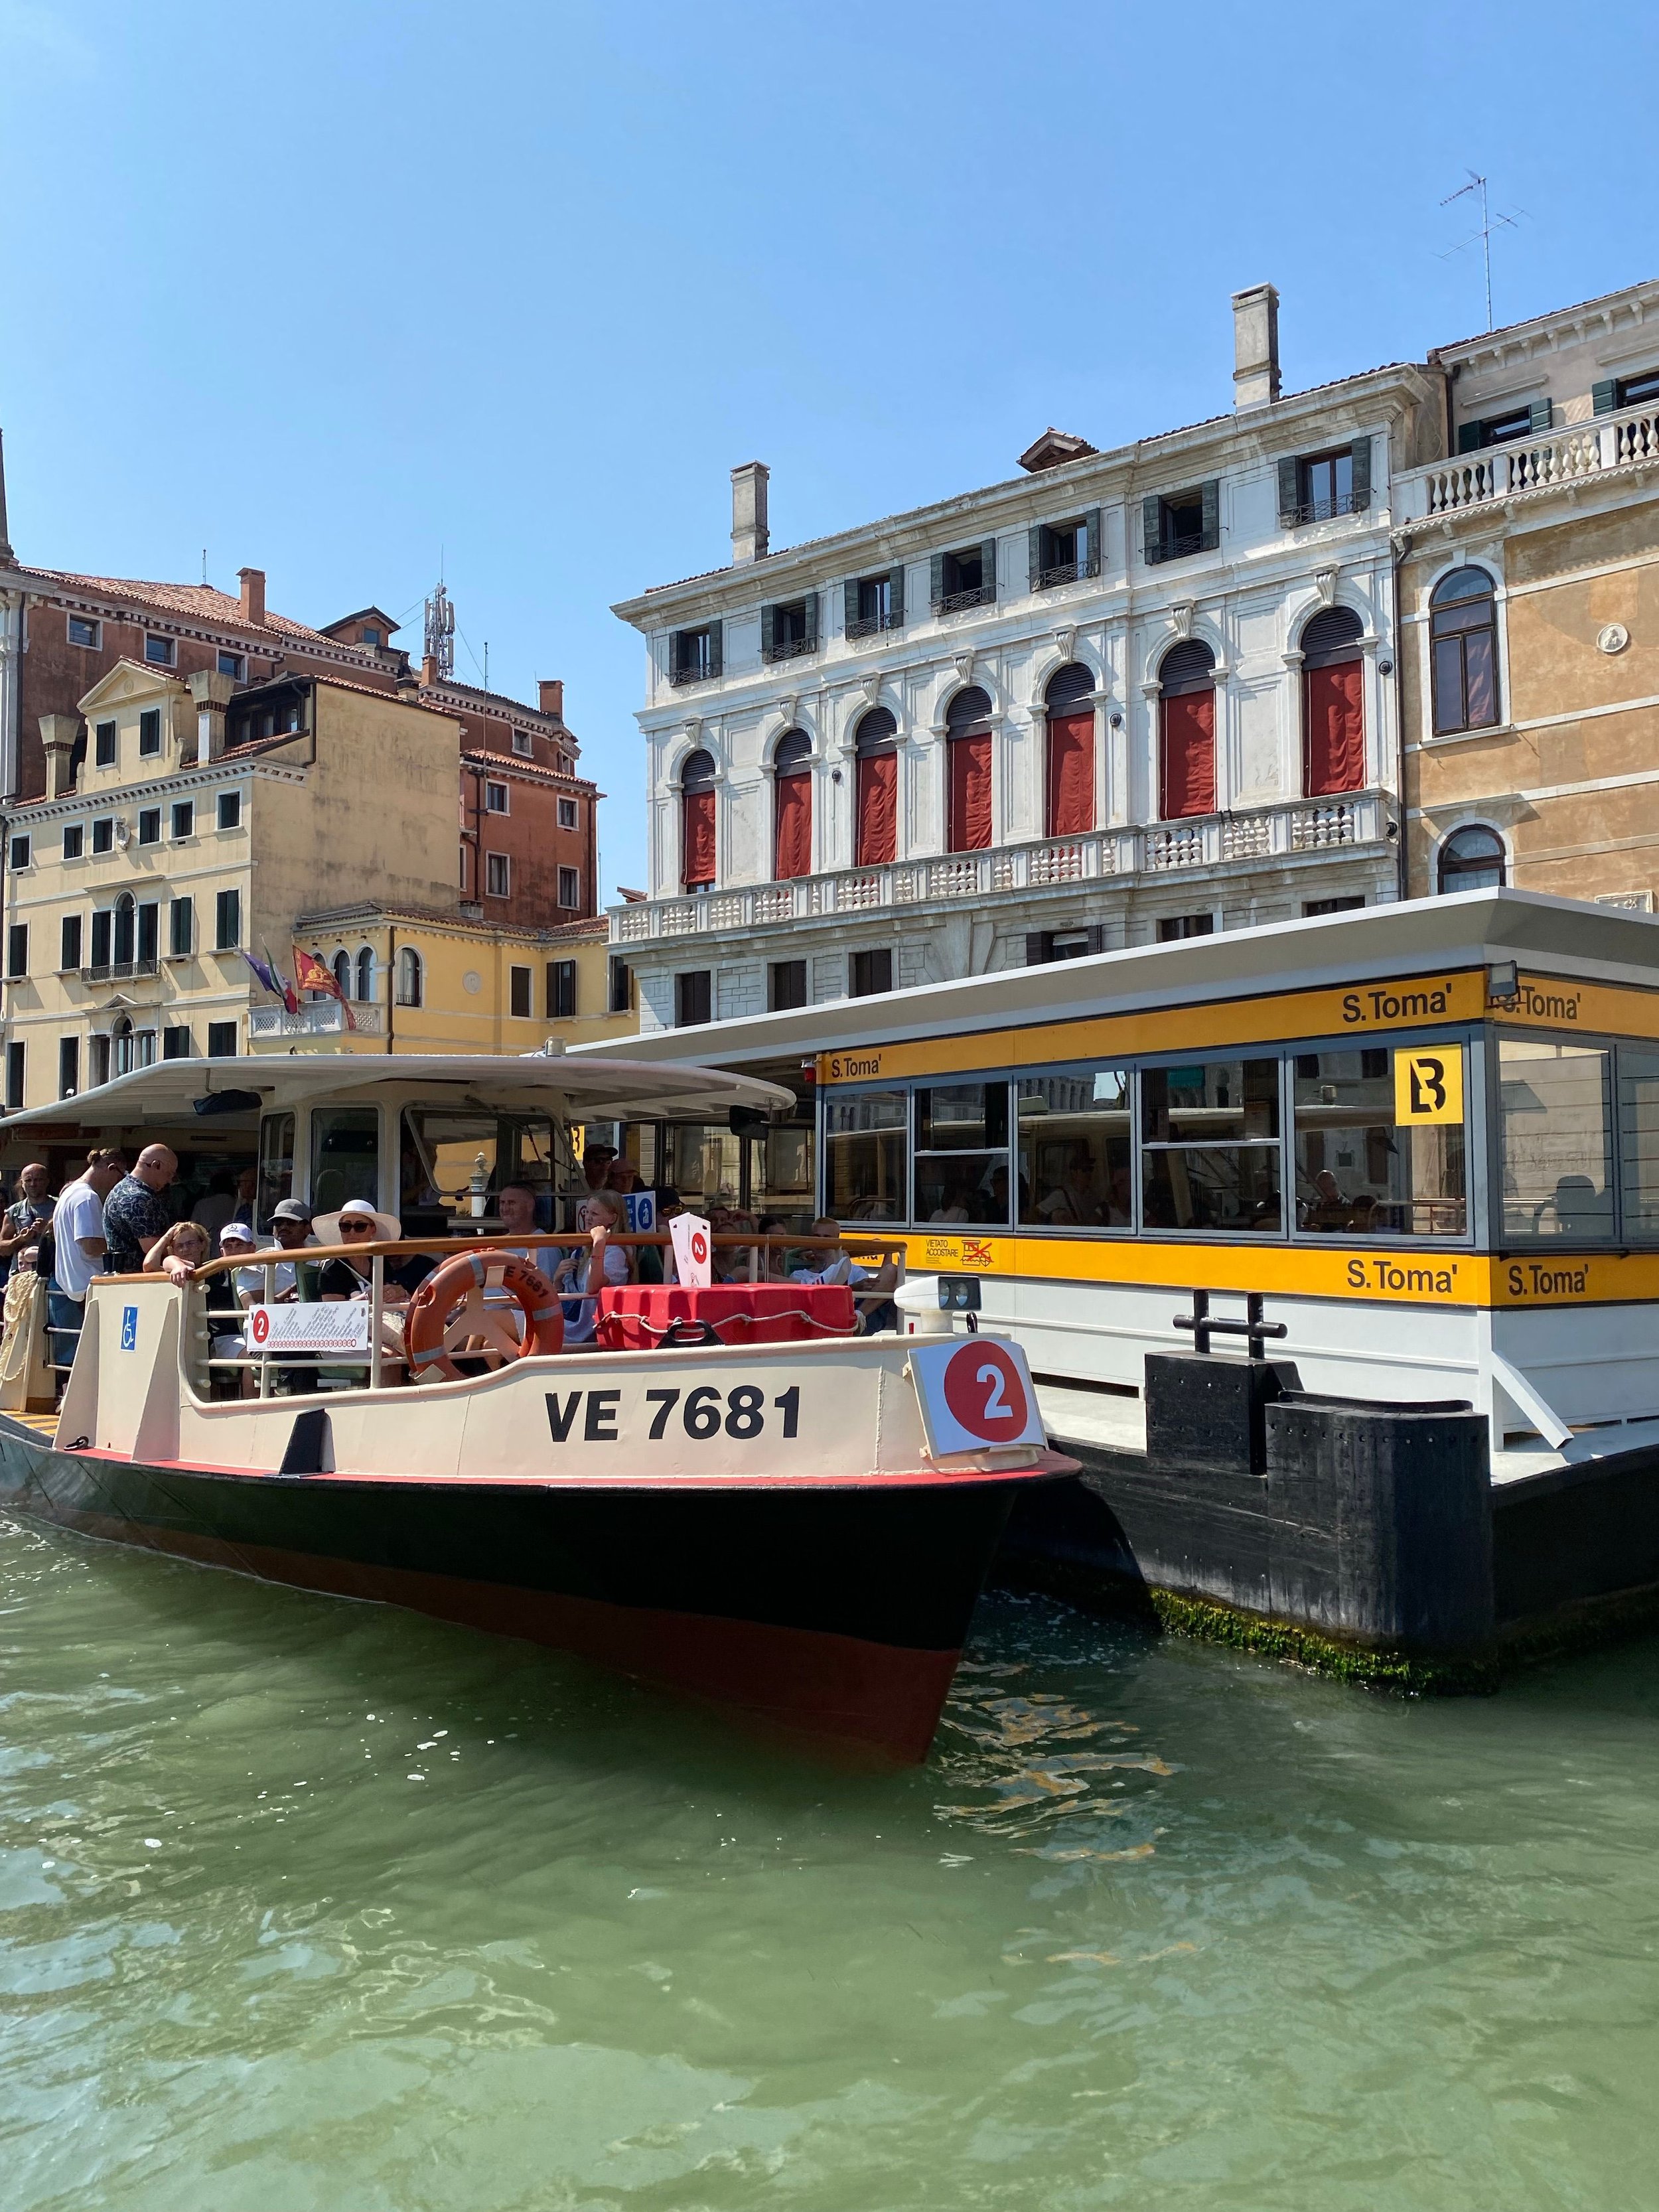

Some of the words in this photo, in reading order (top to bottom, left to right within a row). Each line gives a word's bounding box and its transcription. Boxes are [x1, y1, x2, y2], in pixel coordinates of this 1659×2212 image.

[1409, 1058, 1446, 1114] B
[694, 1241, 704, 1256] 2
[926, 1239, 948, 1248] VIETATO
[926, 1248, 959, 1257] ACCOSTARE
[519, 1270, 549, 1298] 7681
[257, 1317, 265, 1336] 2
[976, 1364, 1013, 1420] 2
[544, 1389, 621, 1443] VE
[646, 1384, 800, 1440] 7681
